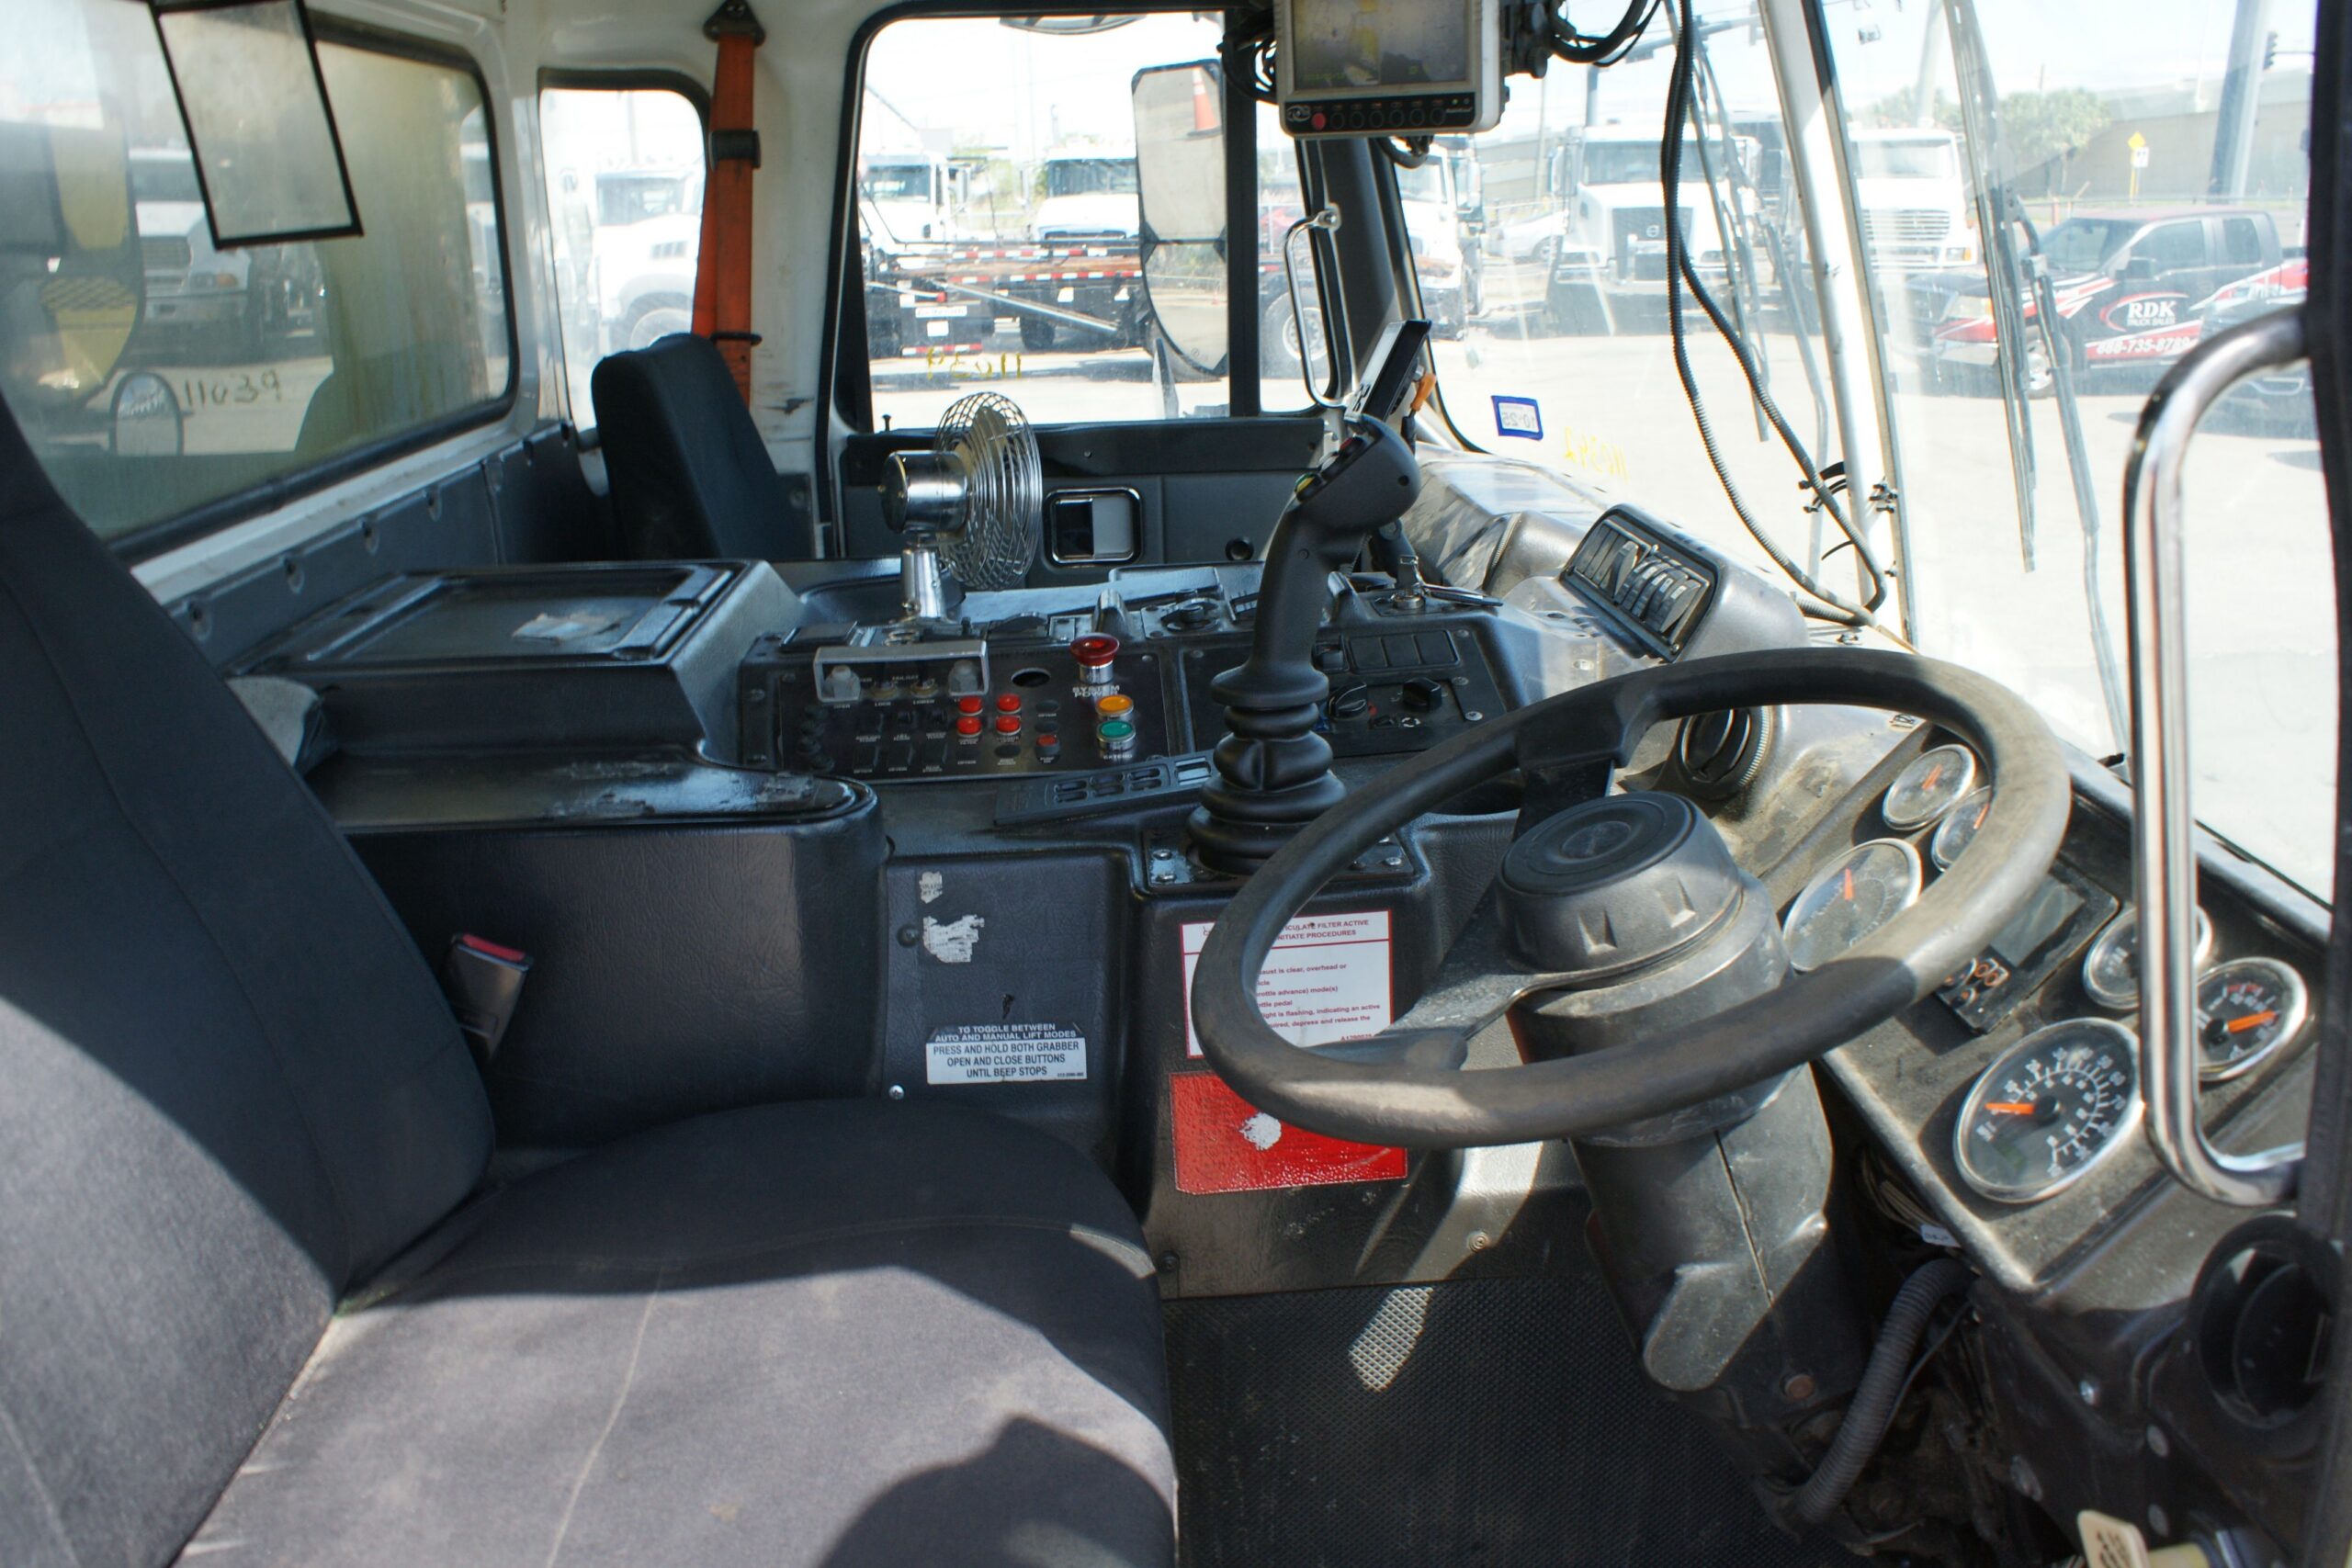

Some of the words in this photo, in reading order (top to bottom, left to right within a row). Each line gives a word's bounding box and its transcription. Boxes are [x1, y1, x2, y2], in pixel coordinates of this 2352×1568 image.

[2128, 300, 2177, 318] RDK
[1072, 684, 1120, 694] SYSTEM
[1306, 930, 1356, 939] PROCEDURES
[1306, 964, 1338, 972] overhead
[1278, 987, 1308, 996] advance)
[1310, 985, 1339, 994] mode(s)
[1285, 1009, 1315, 1017] flashing,
[1317, 1006, 1348, 1015] indicating
[1292, 1020, 1318, 1028] depress
[1335, 1016, 1359, 1024] release
[973, 1024, 1009, 1033] TOGGLE
[1012, 1023, 1056, 1032] BETWEEN
[935, 1034, 959, 1043] AUTO
[961, 1033, 980, 1042] AND
[983, 1032, 1021, 1041] MANUAL
[1023, 1031, 1042, 1039] LIFT
[1044, 1030, 1077, 1039] MODES
[933, 1043, 962, 1055] PRESS
[964, 1043, 982, 1054] AND
[984, 1043, 1009, 1054] HOLD
[1011, 1042, 1035, 1053] BOTH
[1036, 1040, 1080, 1052] GRABBER
[947, 1056, 971, 1067] OPEN
[973, 1055, 992, 1066] AND
[993, 1055, 1023, 1066] CLOSE
[1024, 1054, 1066, 1065] BUTTONS
[967, 1068, 991, 1078] UNTIL
[993, 1067, 1016, 1077] BEEP
[1018, 1066, 1047, 1077] STOPS
